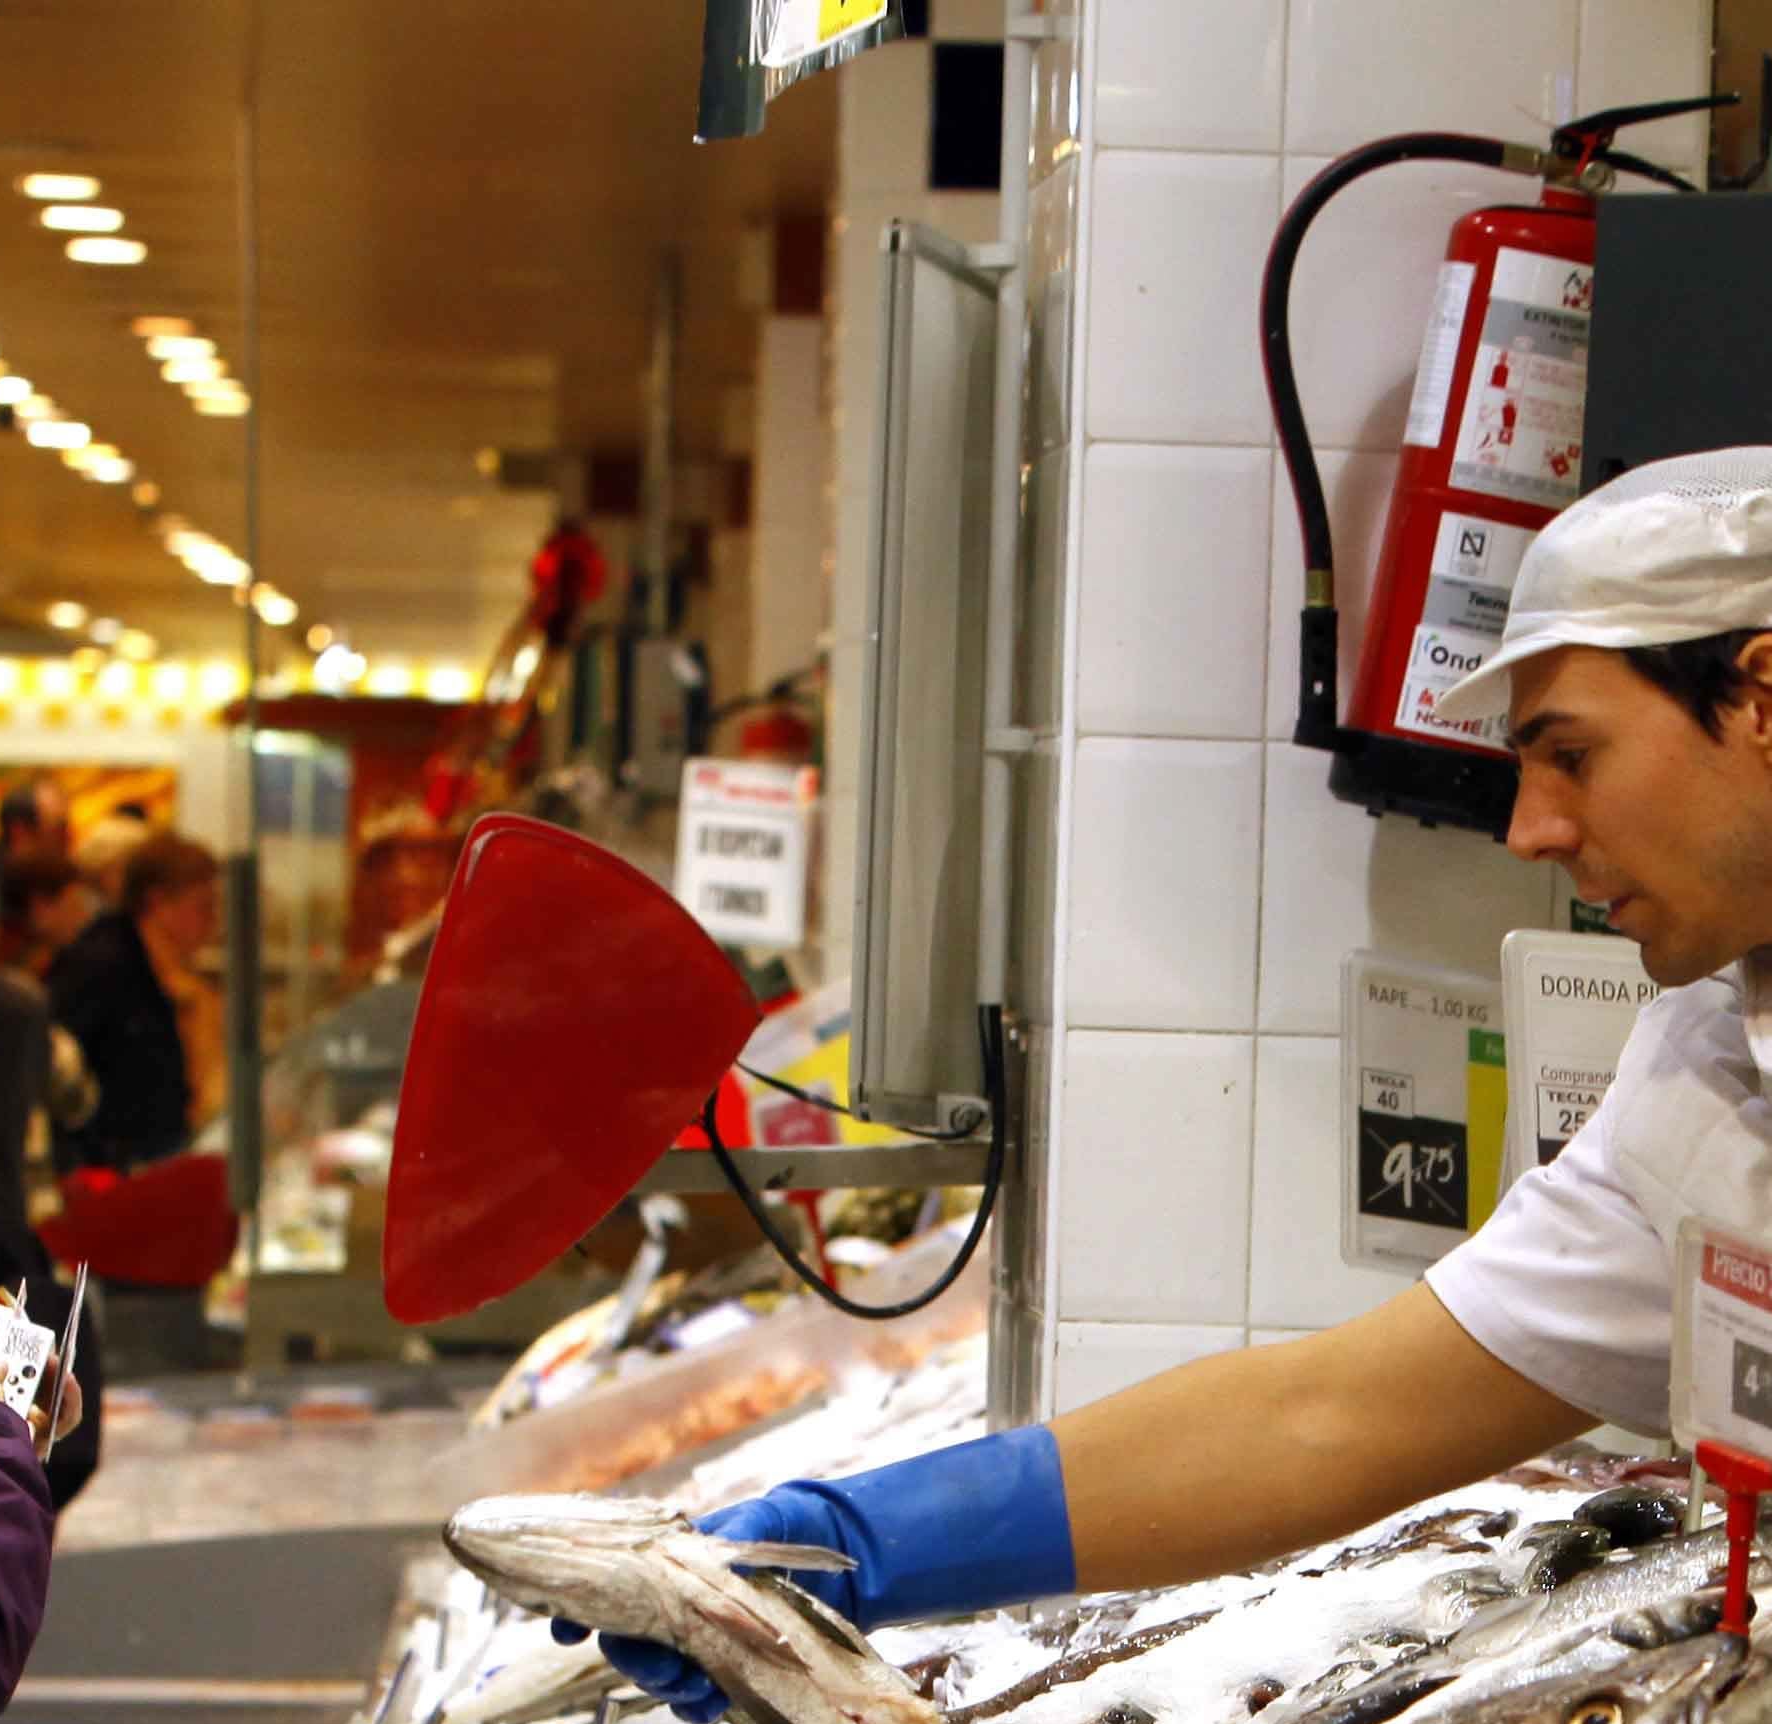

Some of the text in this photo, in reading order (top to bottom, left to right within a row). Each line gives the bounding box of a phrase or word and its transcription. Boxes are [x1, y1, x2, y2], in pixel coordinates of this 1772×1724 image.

[1431, 646, 1483, 673] Ond
[1540, 975, 1630, 1003] DORADA
[1368, 983, 1490, 1024] RAPE 1,00 KG
[1377, 1090, 1399, 1111] 40
[1547, 1090, 1599, 1106] TECLA
[1713, 1248, 1766, 1295] Precio
